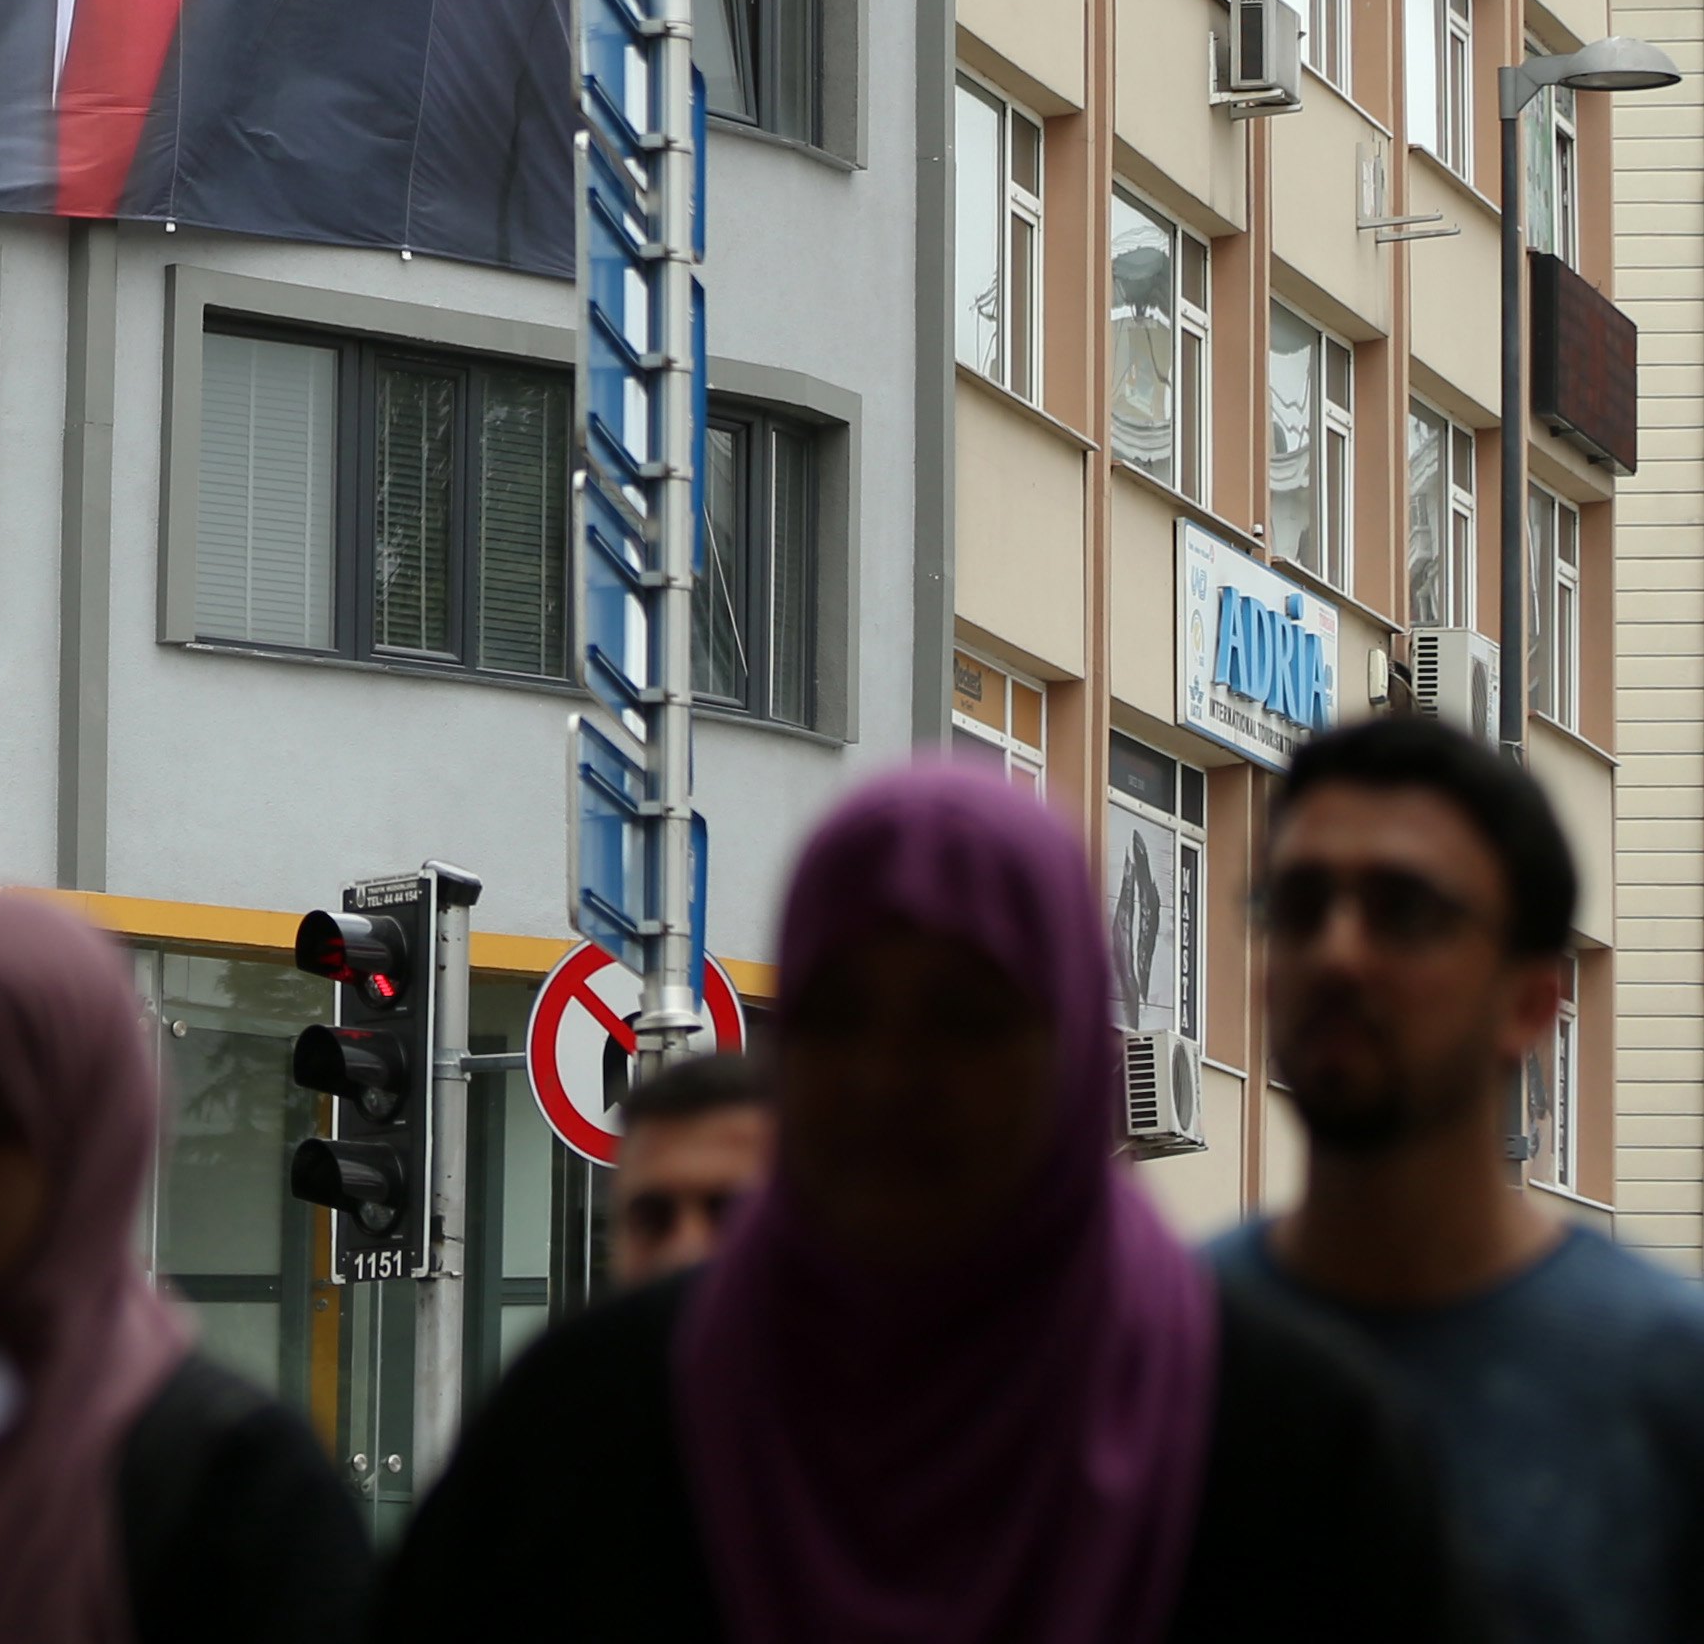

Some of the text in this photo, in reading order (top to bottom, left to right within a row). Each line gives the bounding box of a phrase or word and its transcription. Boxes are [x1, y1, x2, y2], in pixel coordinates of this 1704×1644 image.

[1209, 697, 1257, 740] INTERNATIONAL
[367, 896, 383, 908] TEL:
[384, 893, 393, 904] 44
[394, 892, 403, 903] 44
[354, 1250, 403, 1280] 1151
